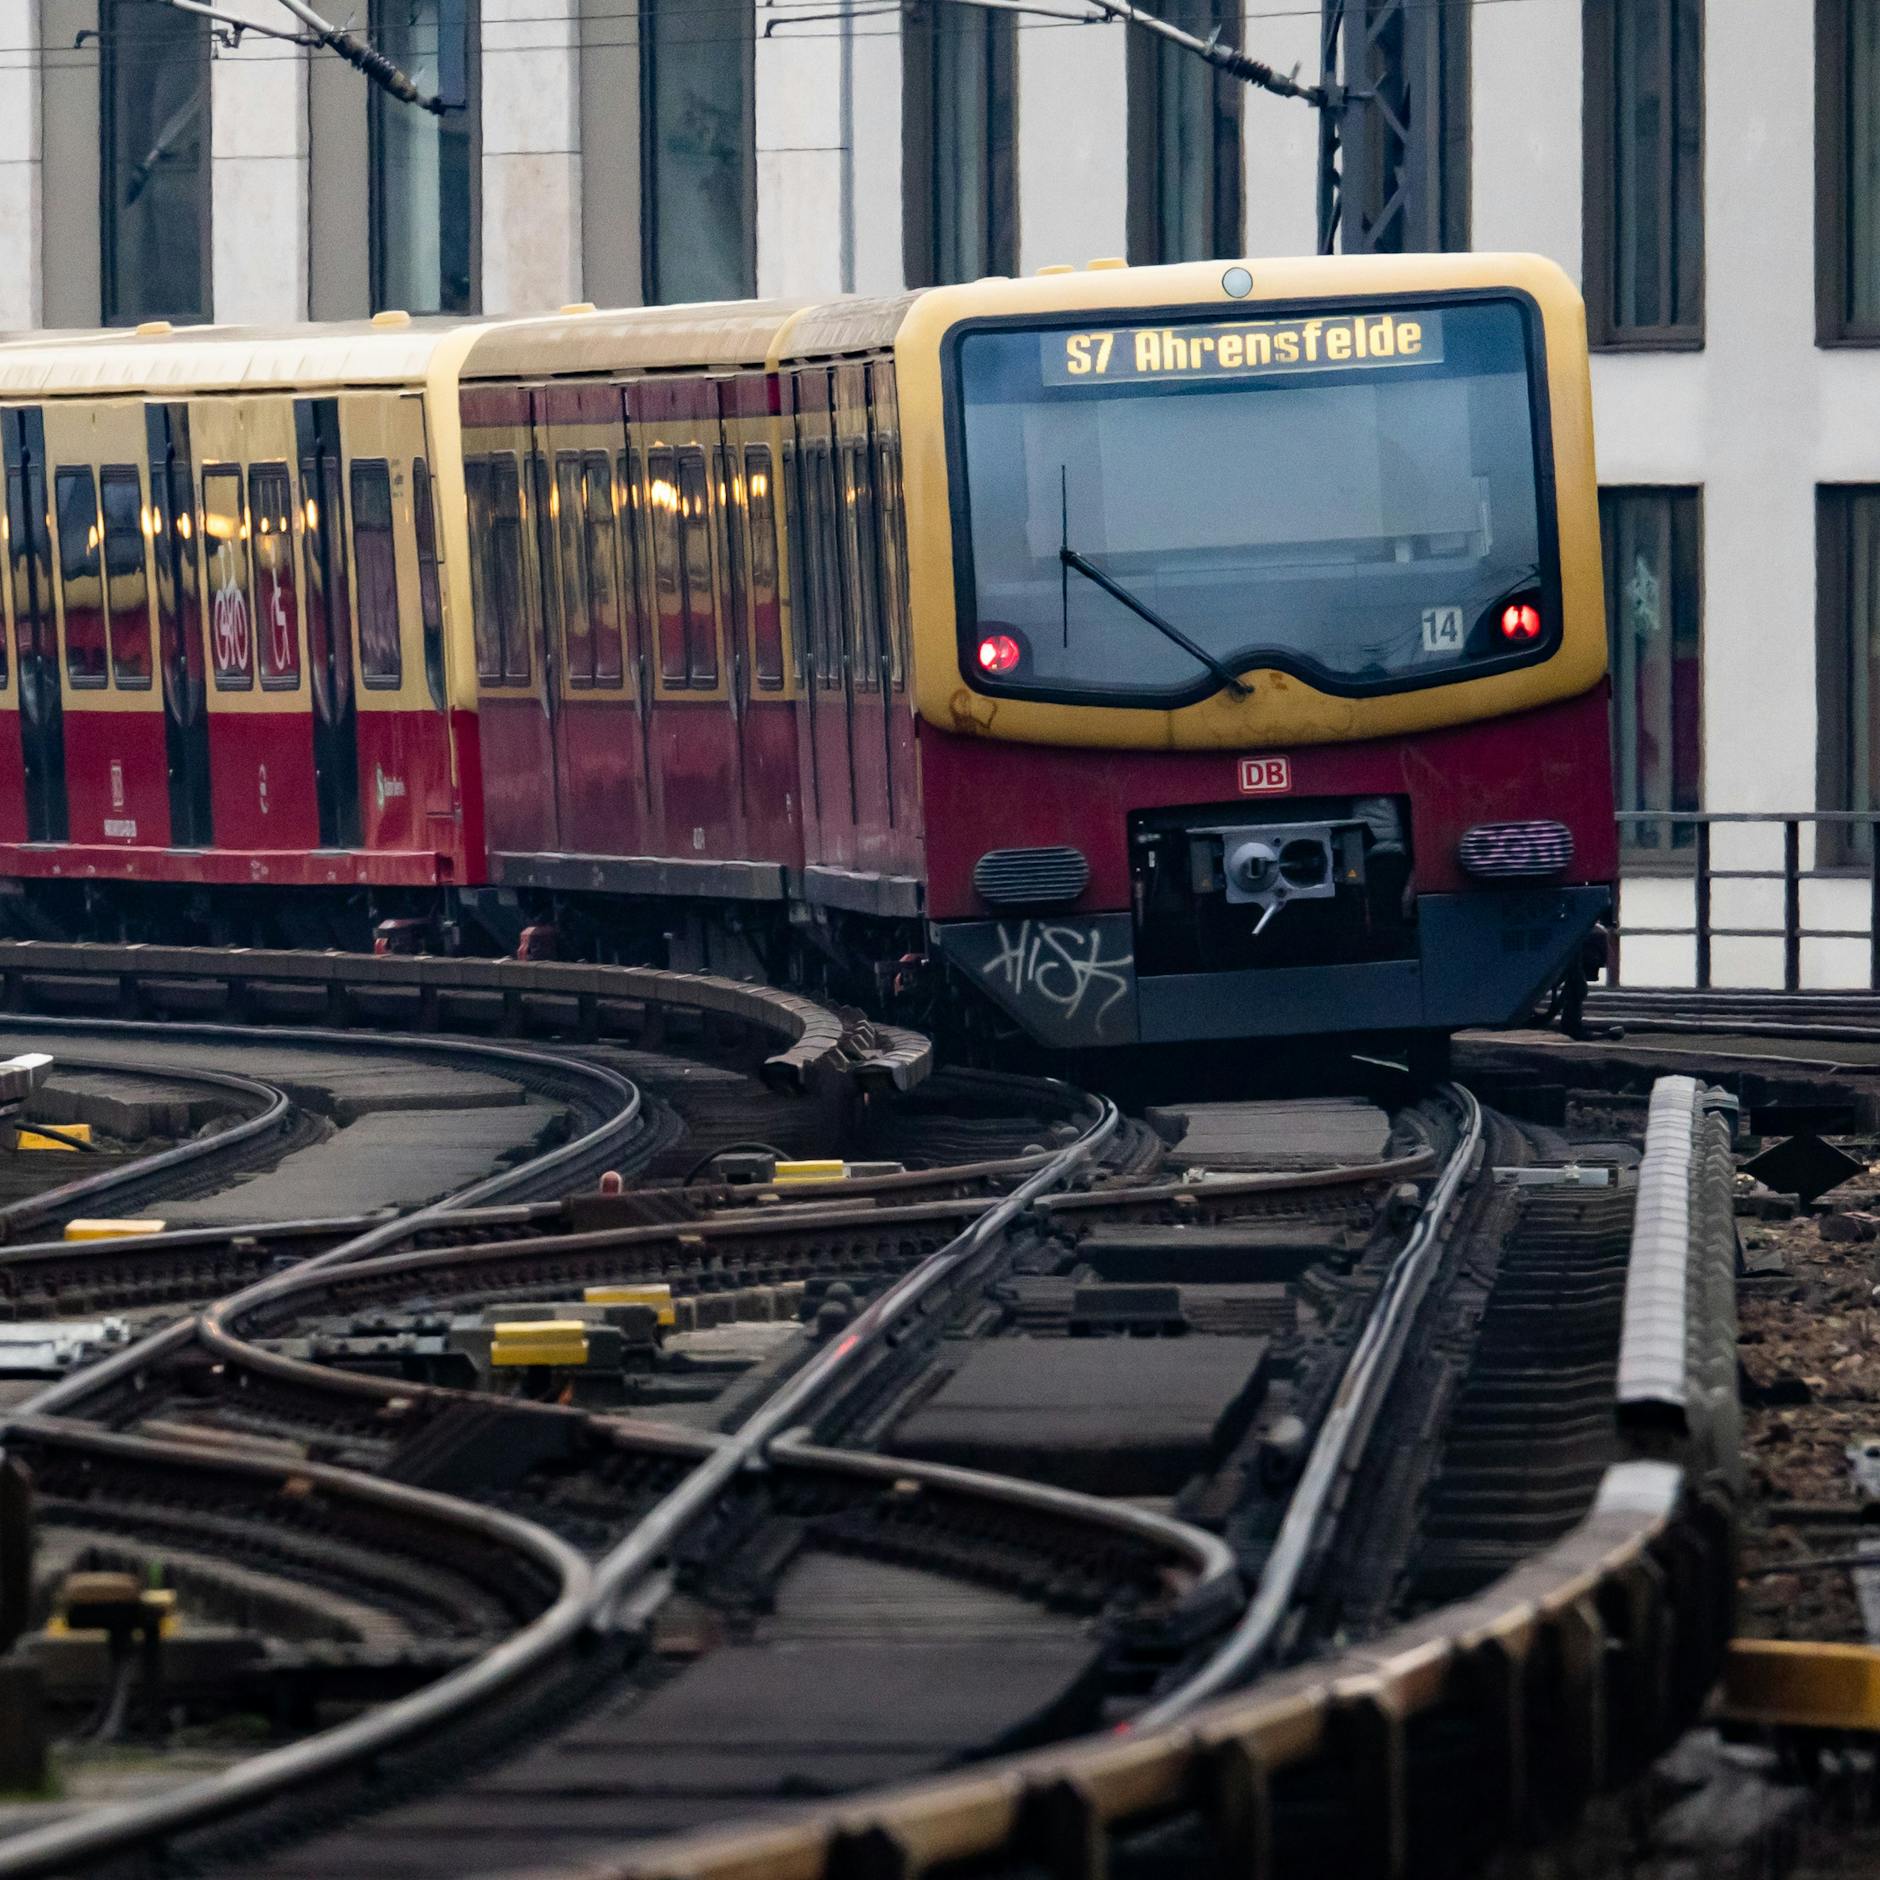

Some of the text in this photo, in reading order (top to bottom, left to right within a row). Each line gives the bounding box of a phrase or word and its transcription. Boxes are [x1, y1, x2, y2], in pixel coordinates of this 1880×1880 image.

[1066, 315, 1423, 375] S7 Ahrensfelde
[1423, 611, 1458, 644] 14
[1245, 762, 1284, 786] DB
